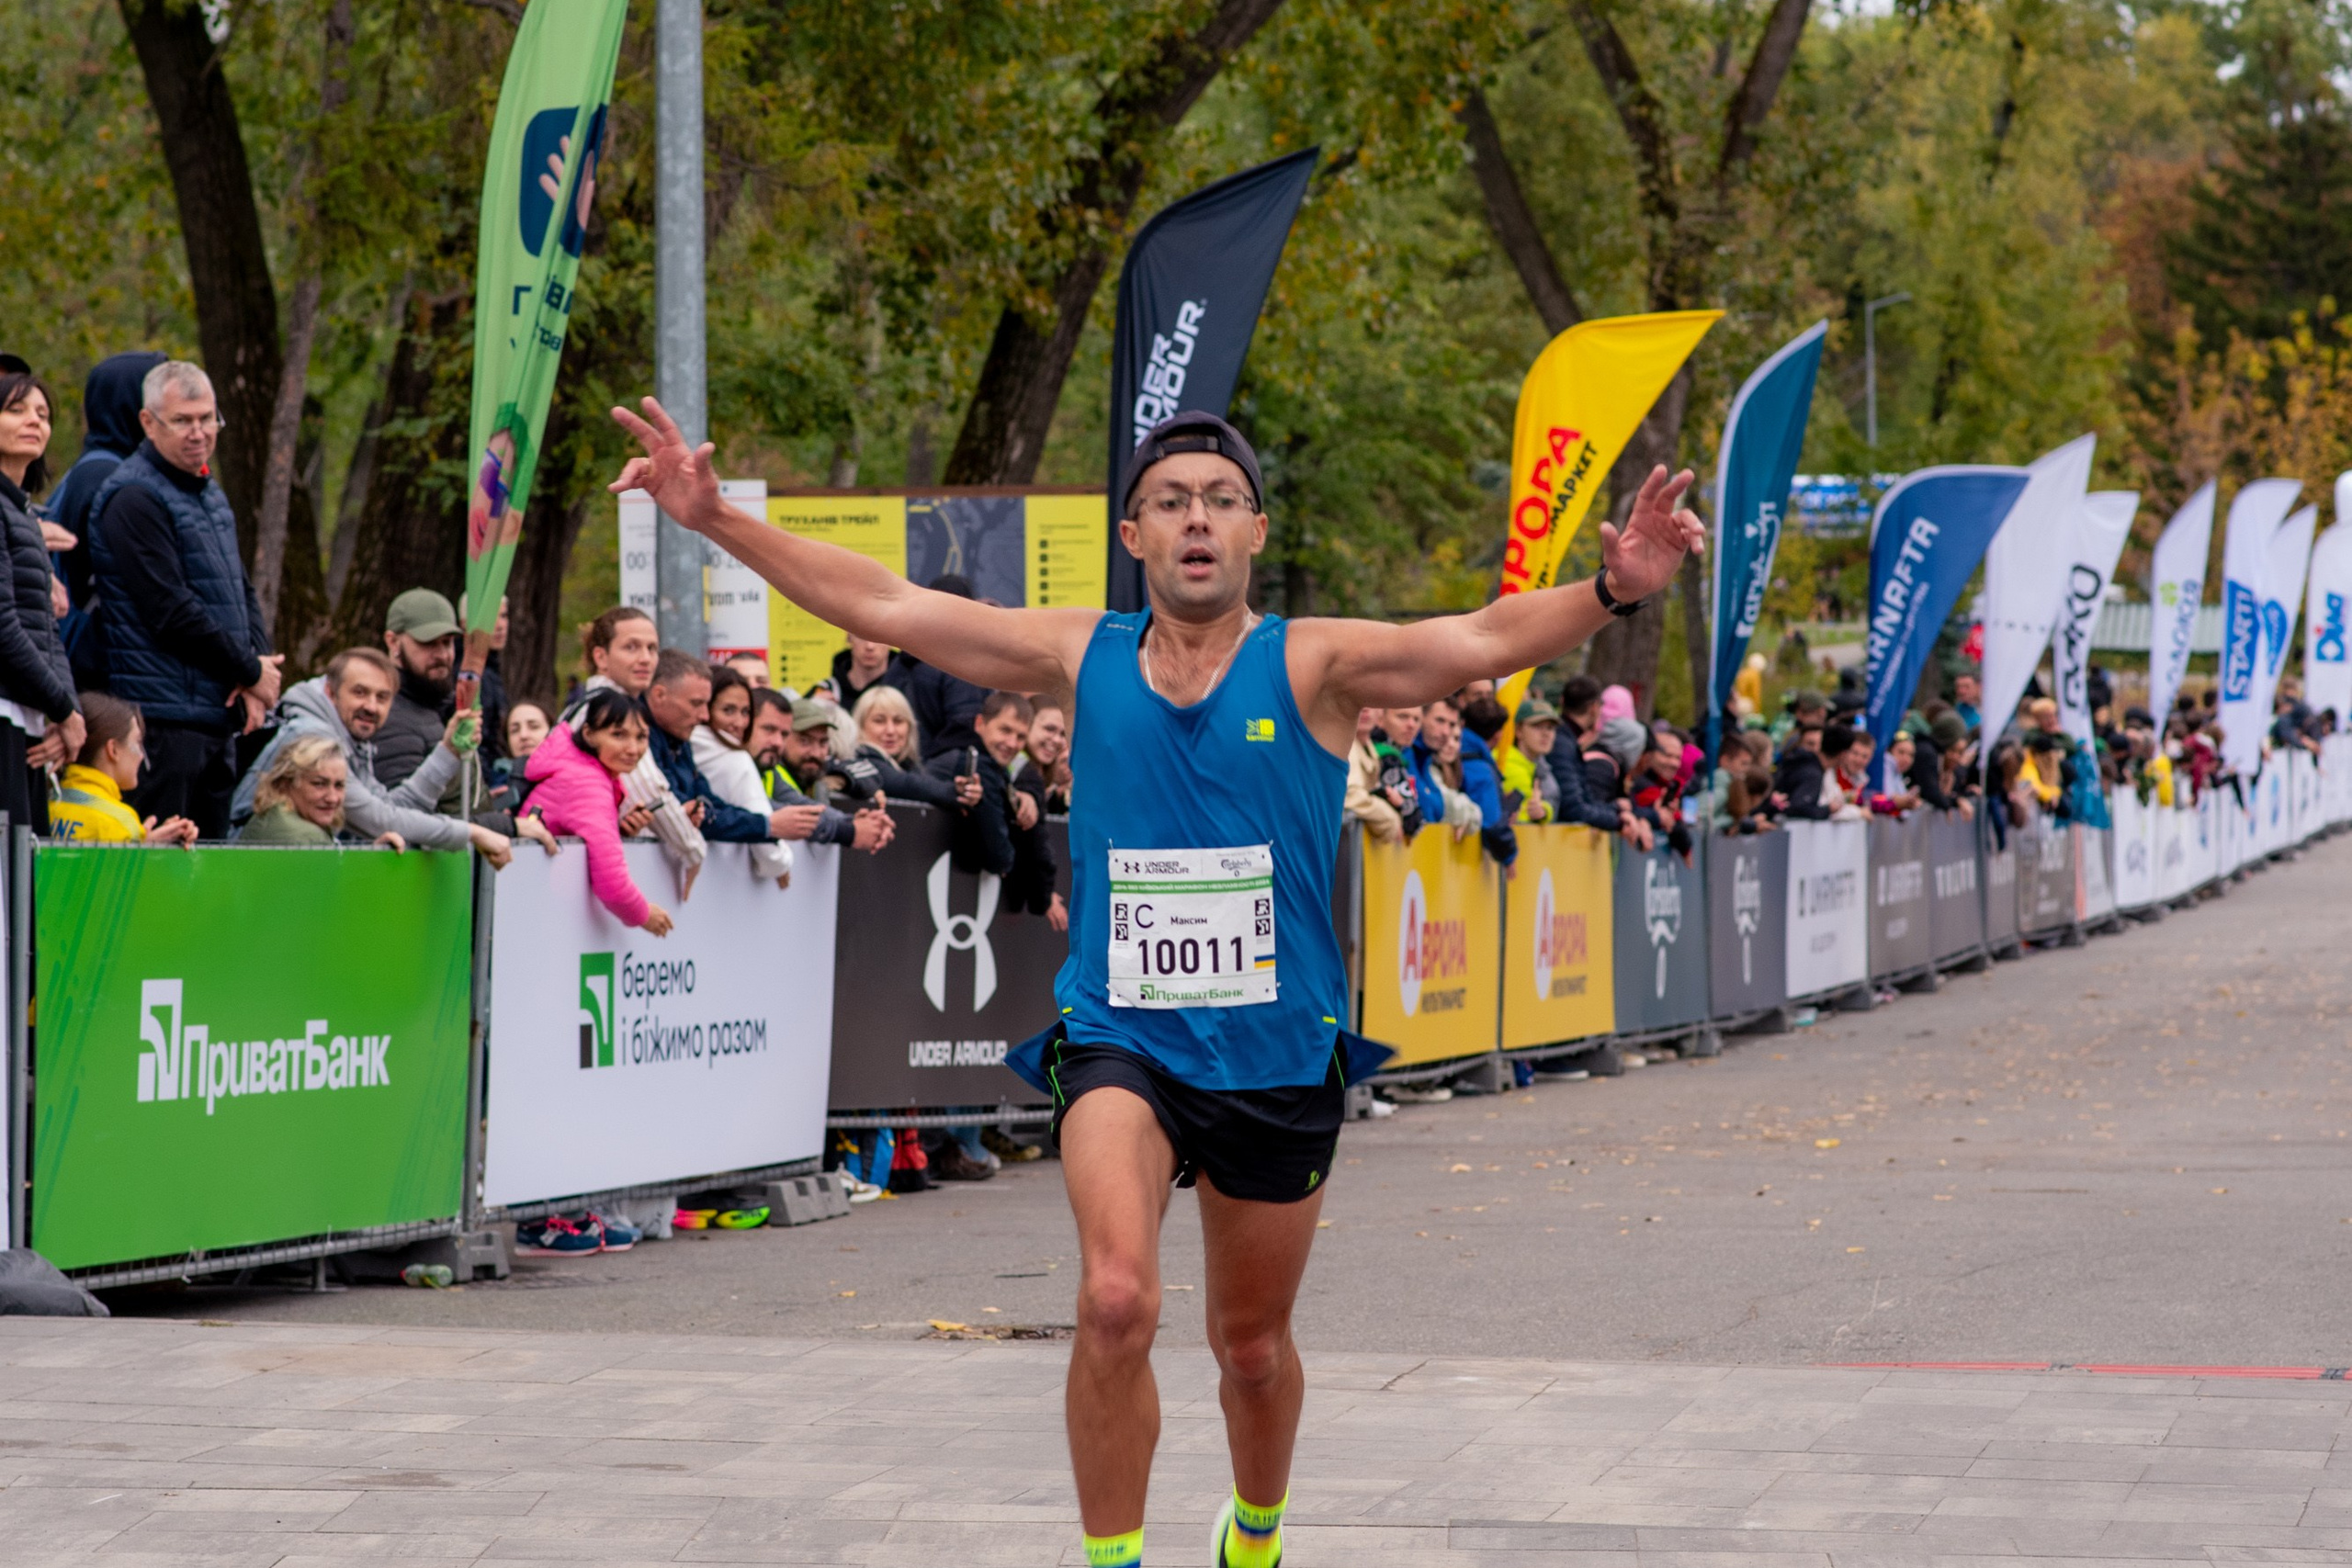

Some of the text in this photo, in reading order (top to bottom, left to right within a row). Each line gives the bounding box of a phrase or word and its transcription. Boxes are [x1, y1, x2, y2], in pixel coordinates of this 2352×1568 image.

[1158, 299, 1206, 427] MOUR
[1499, 427, 1581, 597] РОРА
[1866, 515, 1940, 682] RNAFTA
[1170, 916, 1208, 926] Максим
[622, 950, 696, 1010] беремо
[1137, 936, 1243, 976] 10011
[1156, 988, 1244, 1003] ПриватБанк
[181, 1019, 391, 1116] ПриватБанк
[622, 1014, 767, 1069] і біжимо разом
[909, 1039, 1009, 1067] UNDER ARMOUR
